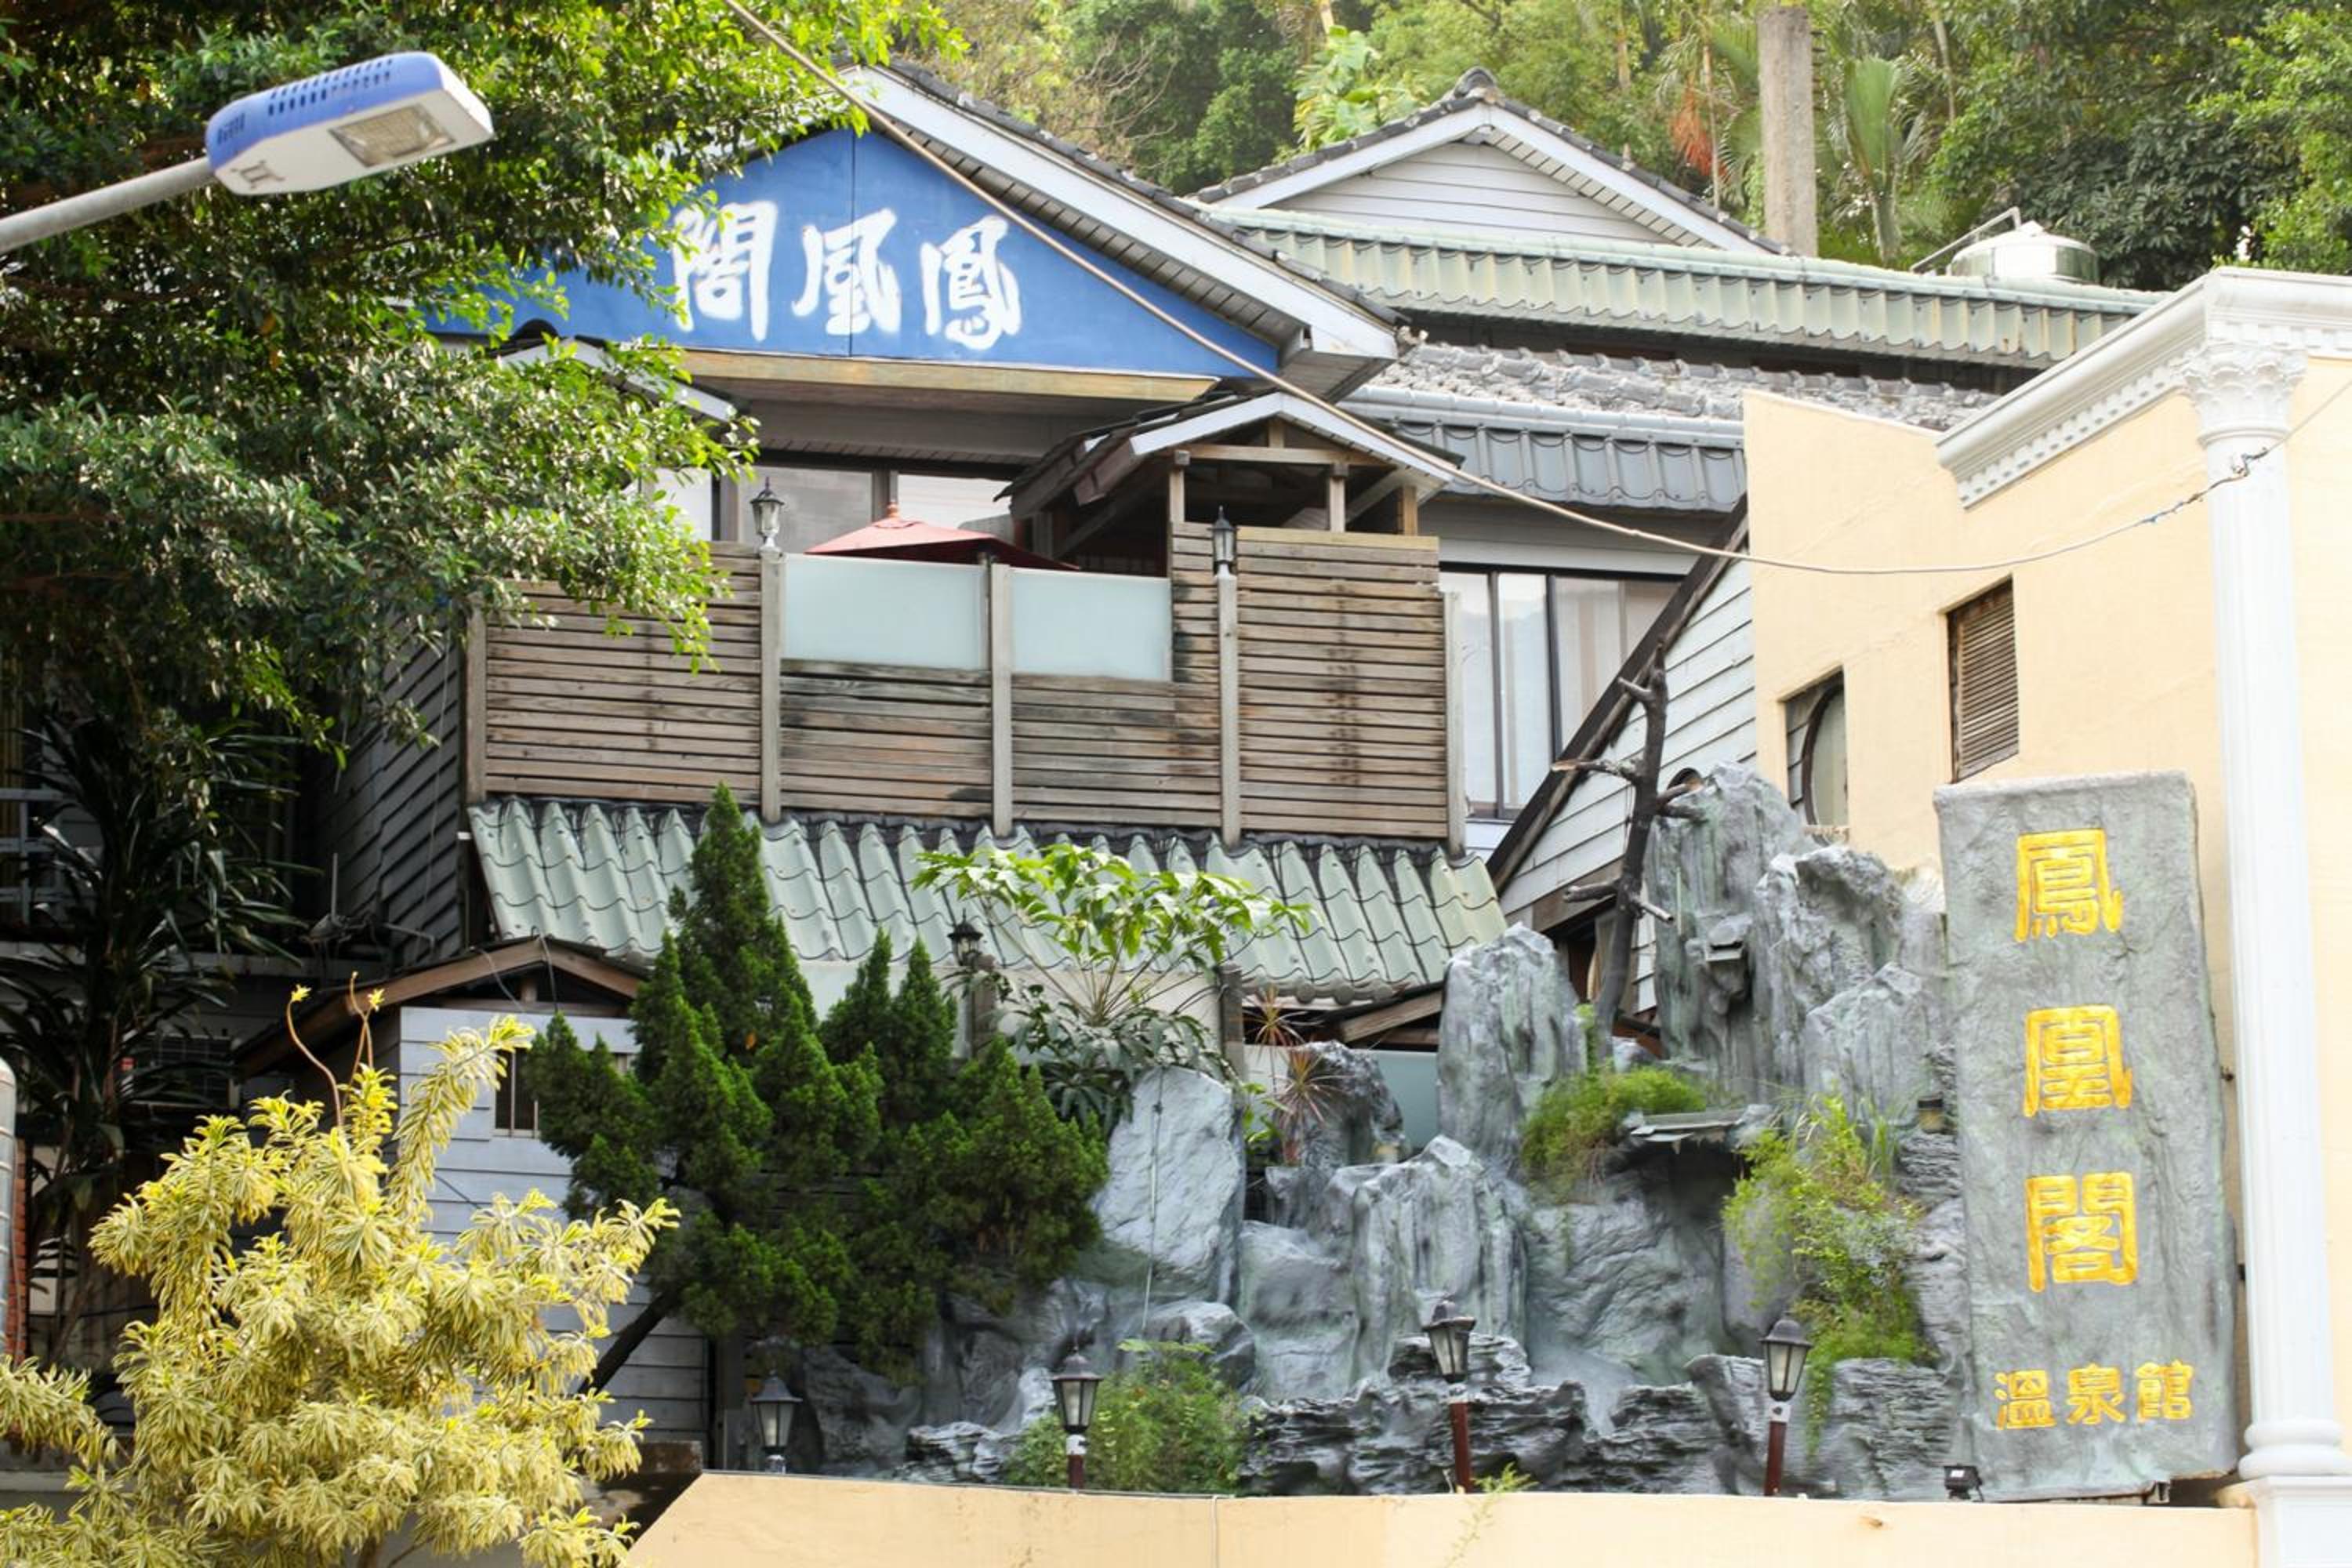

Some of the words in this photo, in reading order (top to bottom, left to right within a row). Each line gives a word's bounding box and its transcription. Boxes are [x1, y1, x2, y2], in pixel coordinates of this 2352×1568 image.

[2014, 827, 2139, 1292] 鳳凰閣
[1994, 1359, 2194, 1430] 溫泉館
